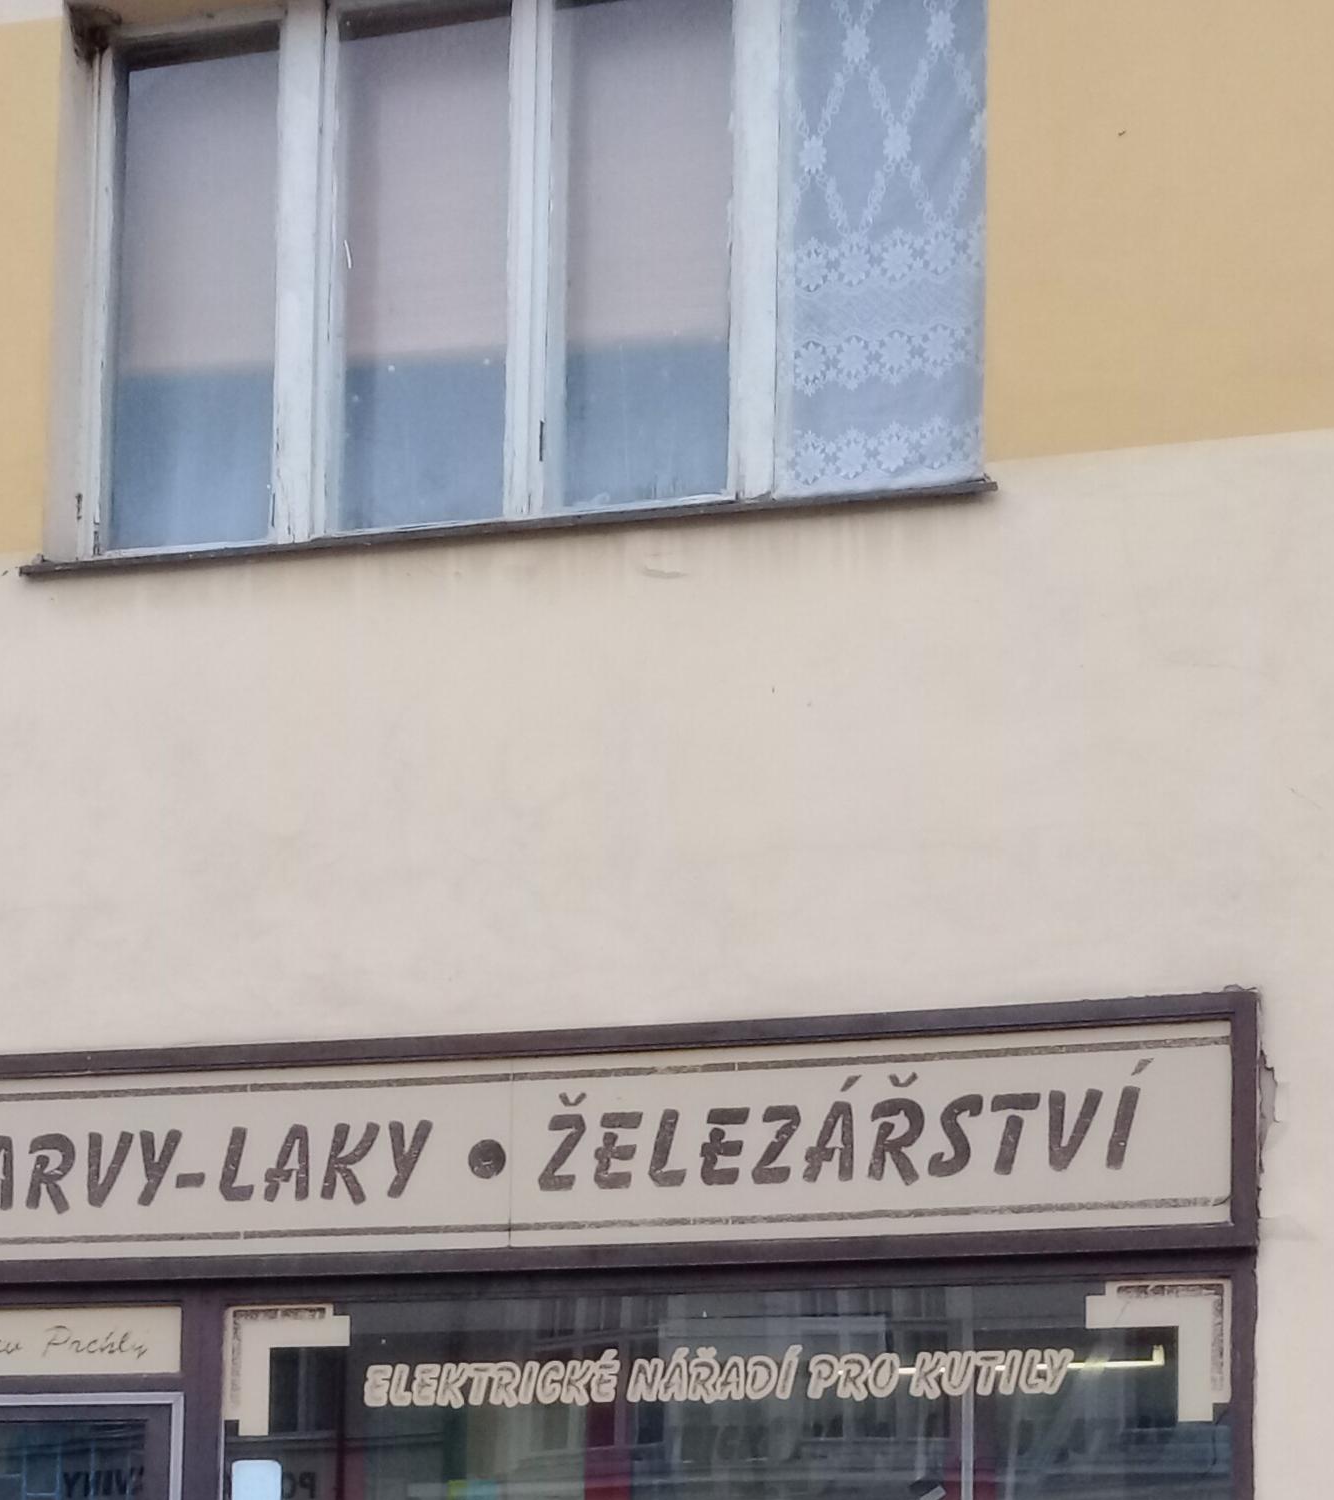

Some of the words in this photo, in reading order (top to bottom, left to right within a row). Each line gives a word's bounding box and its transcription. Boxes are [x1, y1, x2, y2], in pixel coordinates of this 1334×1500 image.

[537, 1057, 1155, 1192] ŽELEZÁŘSTVÍ
[364, 1348, 621, 1409] ELEKTRICKÉ
[625, 1344, 803, 1404] NÁŘADÍ
[807, 1352, 900, 1401] PRO
[909, 1347, 1074, 1400] KUTILY
